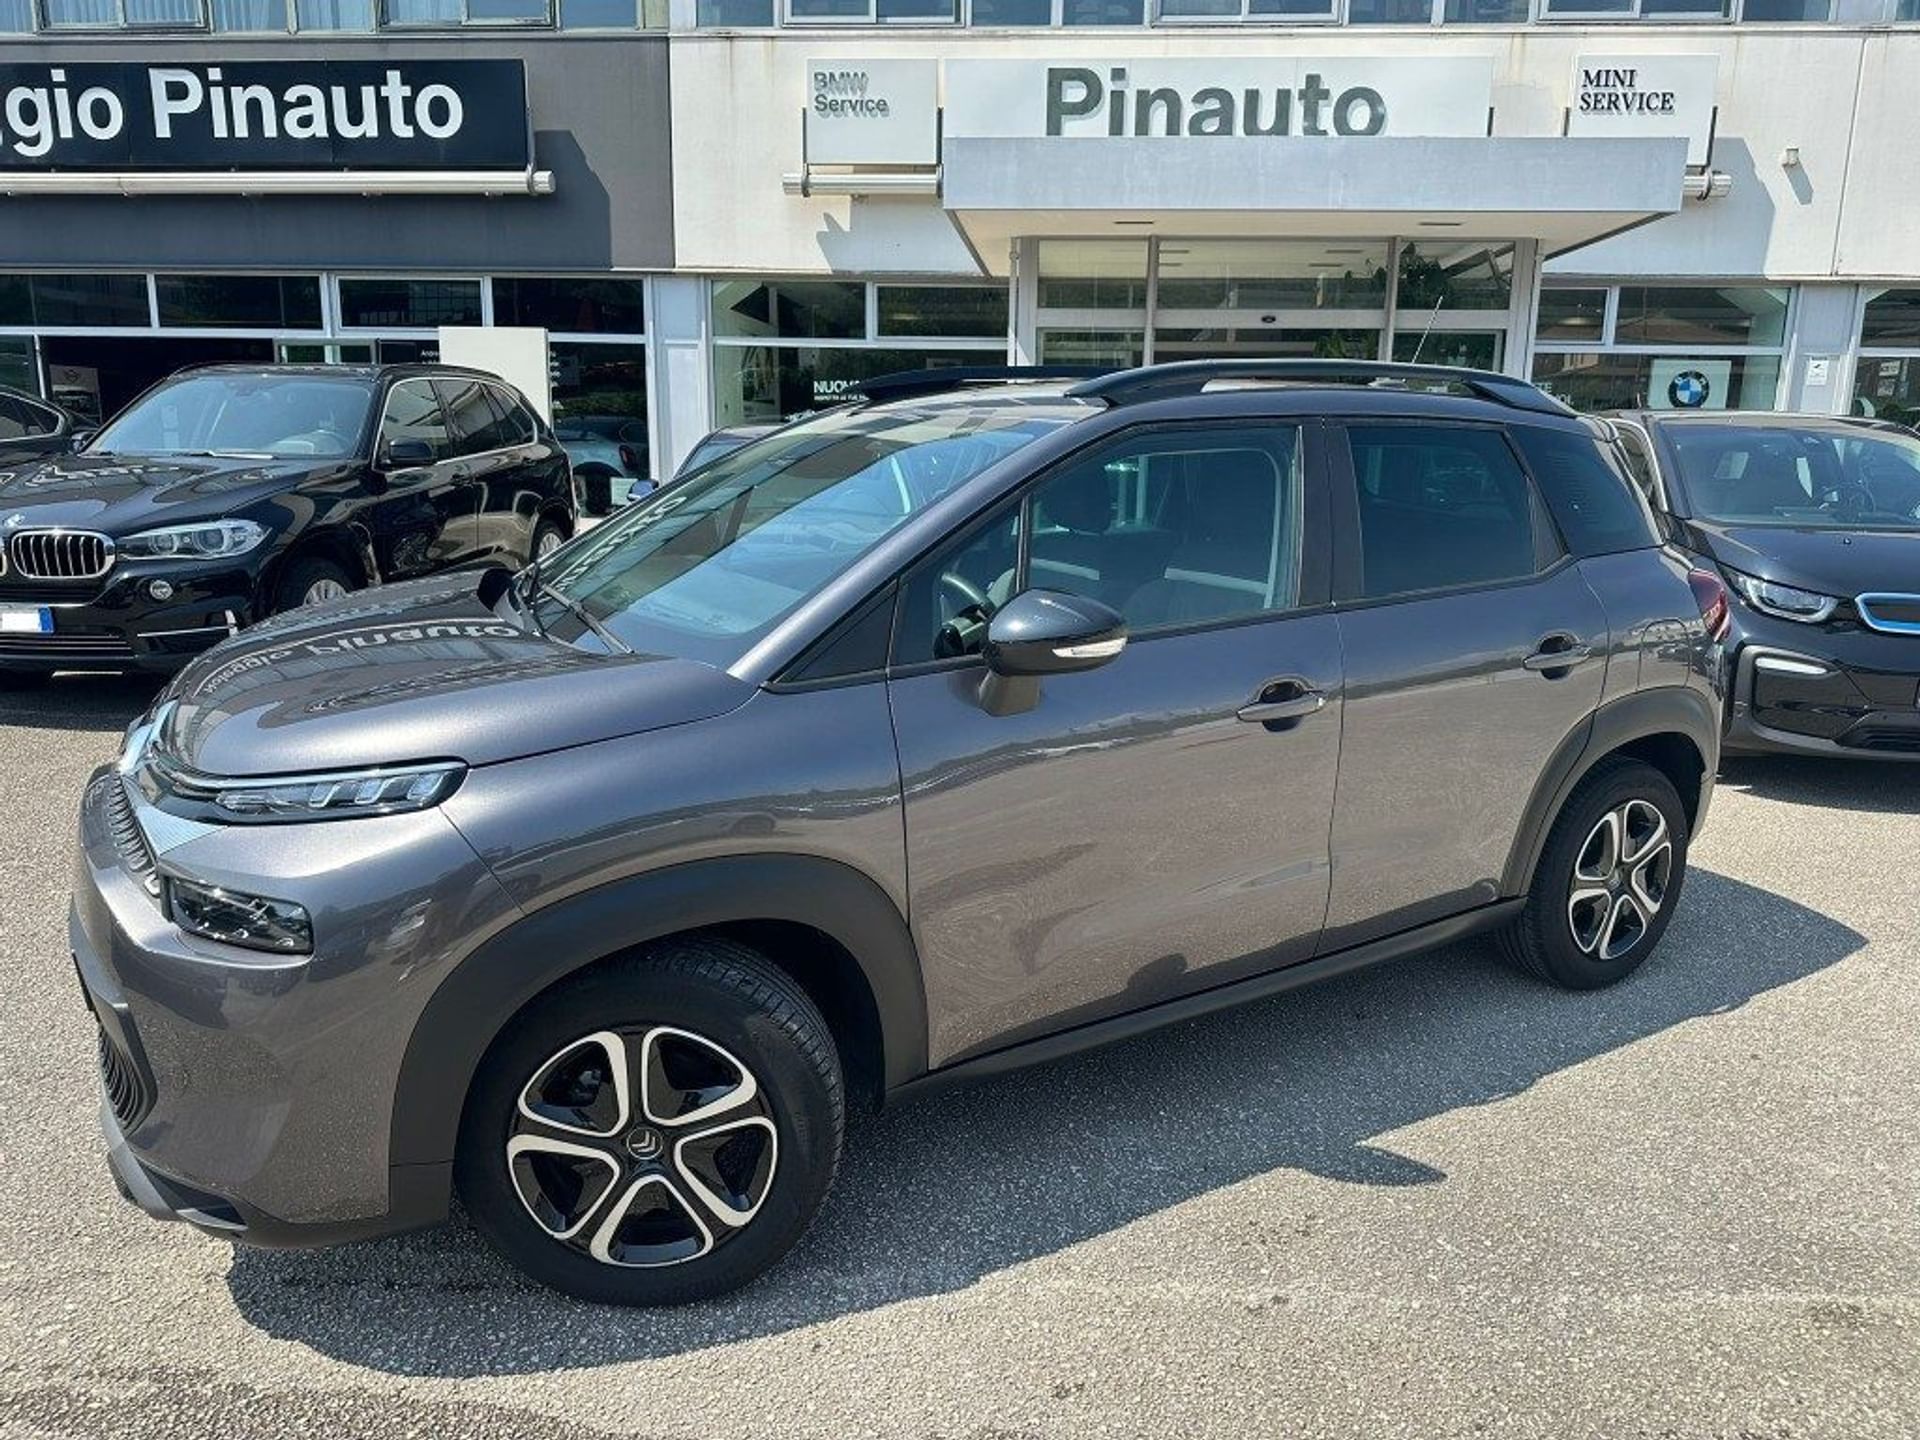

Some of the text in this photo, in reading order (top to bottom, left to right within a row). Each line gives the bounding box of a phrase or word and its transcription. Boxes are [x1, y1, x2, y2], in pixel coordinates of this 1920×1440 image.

[813, 71, 868, 91] BMW
[1581, 69, 1637, 88] MINI
[814, 93, 889, 113] Service
[1045, 66, 1388, 137] Pinauto
[1579, 91, 1675, 112] SERVICE
[0, 67, 464, 157] gio Pinauto
